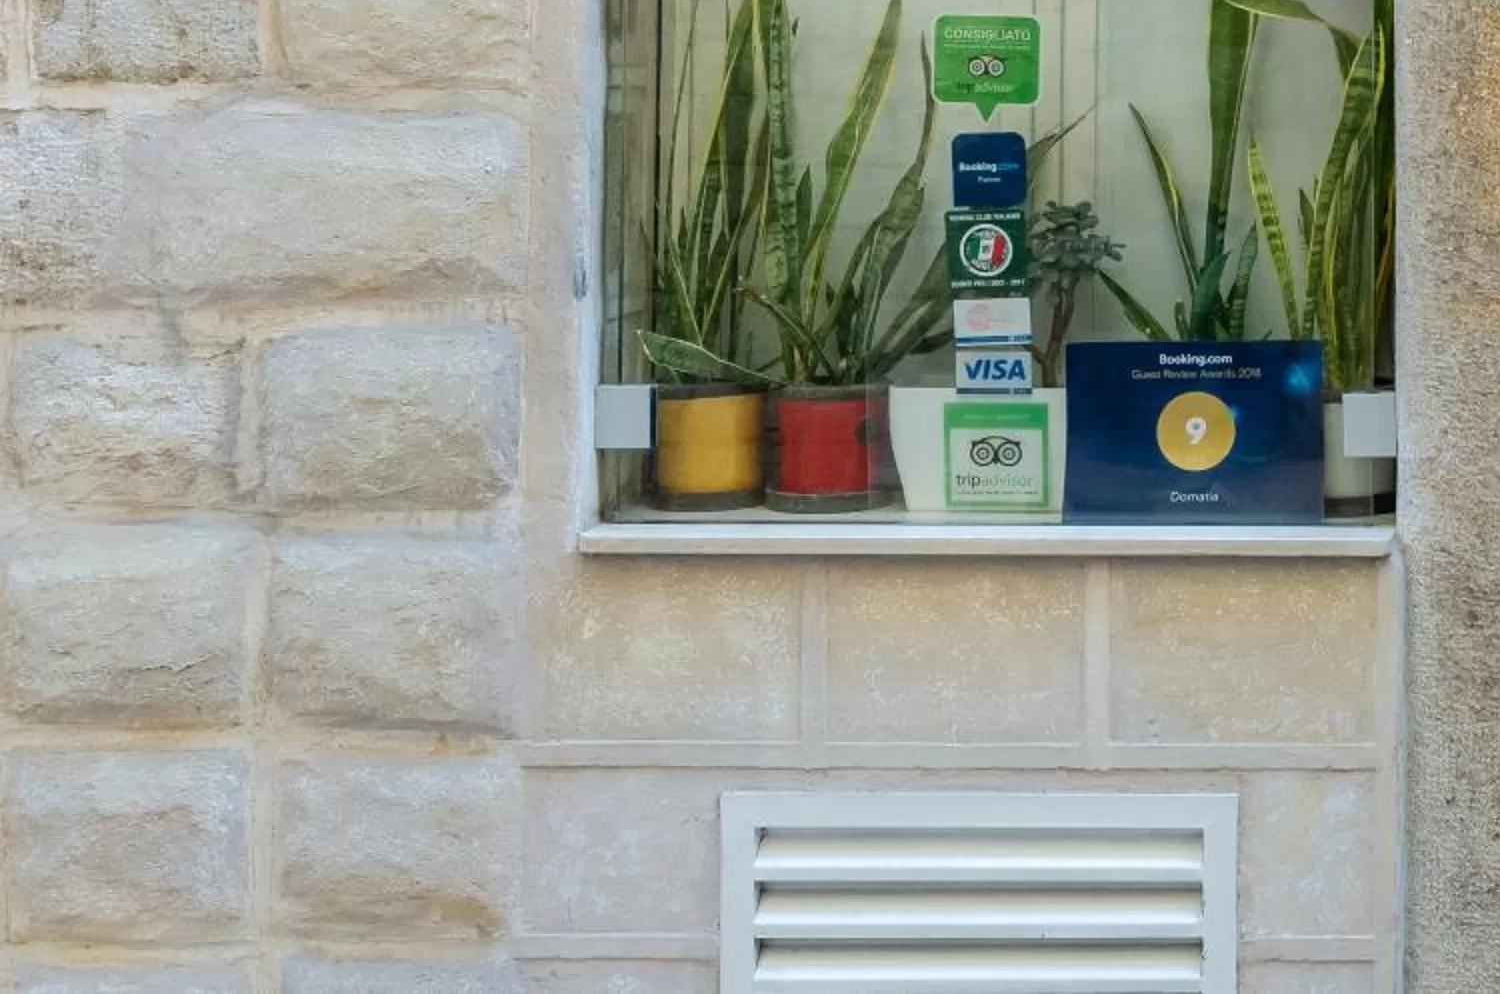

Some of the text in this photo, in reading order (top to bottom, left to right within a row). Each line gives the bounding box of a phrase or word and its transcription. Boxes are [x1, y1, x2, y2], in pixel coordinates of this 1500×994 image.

[943, 28, 1031, 41] CONSIGLIATO
[958, 161, 1020, 173] Booking.com
[1159, 353, 1233, 367] Booking.com
[965, 359, 1027, 380] VISA
[1131, 369, 1161, 380] Guest
[1185, 417, 1208, 445] 9
[955, 473, 1035, 490] tripadvisor
[1170, 490, 1220, 504] Domatia
